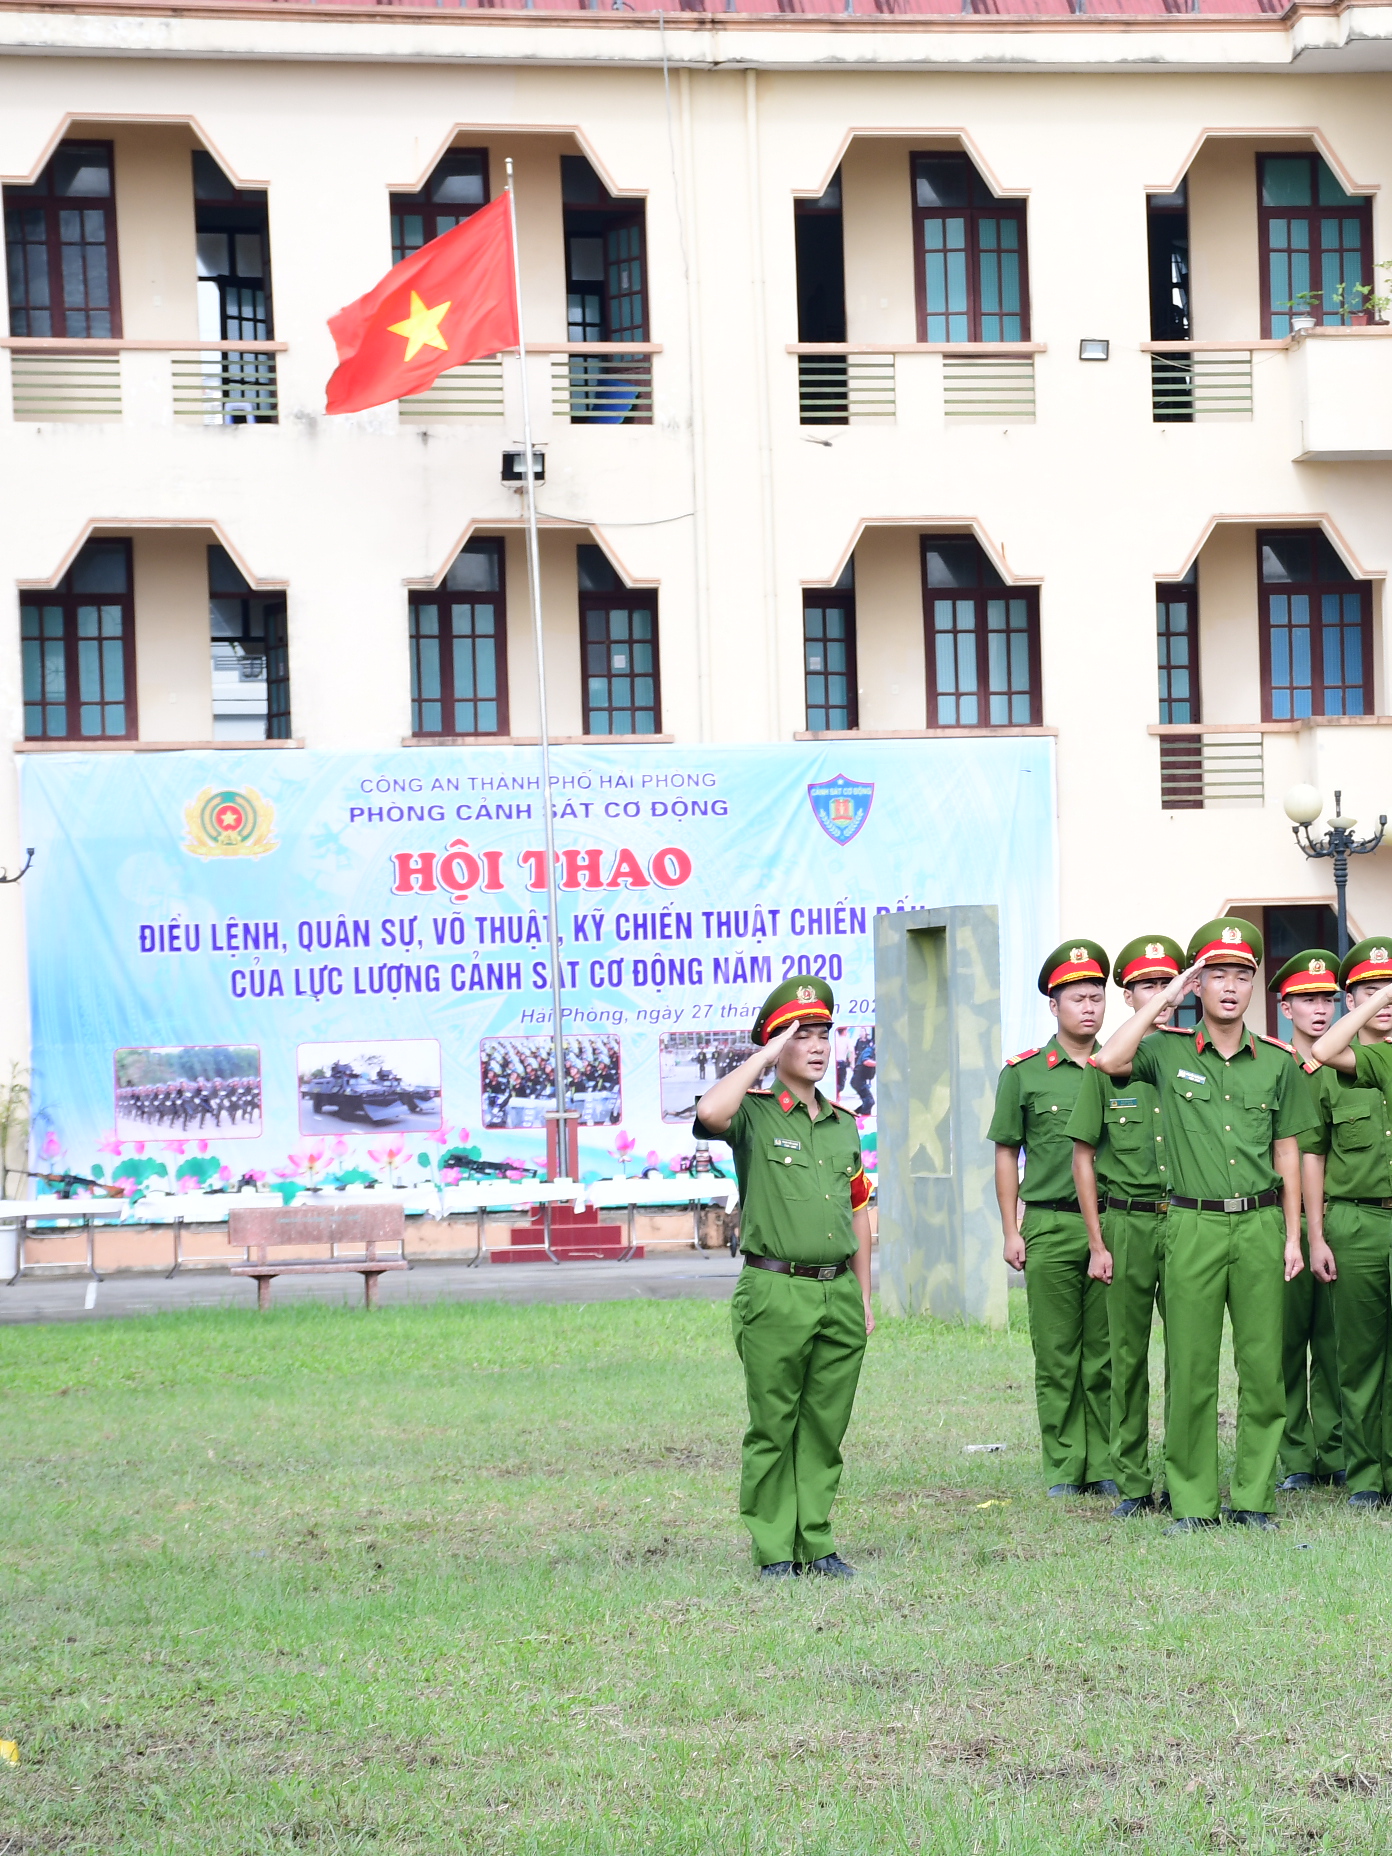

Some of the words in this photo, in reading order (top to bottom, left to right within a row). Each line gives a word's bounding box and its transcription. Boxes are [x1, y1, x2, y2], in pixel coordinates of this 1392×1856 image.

[360, 774, 423, 793] CÔNG
[430, 777, 460, 792] AN
[467, 772, 540, 791] THÀNH
[549, 769, 592, 789] PHỐ
[600, 770, 634, 789] HẢI
[641, 770, 717, 789] PHÒNG
[349, 801, 446, 823] PHÒNG
[456, 797, 532, 821] CẢNH
[604, 801, 641, 818] CƠ
[650, 796, 729, 822] ĐỘNG
[392, 837, 505, 902] HỘI
[518, 846, 693, 891] THAO
[138, 913, 201, 953] ĐIỀU
[211, 916, 288, 958] LỆNH,
[298, 913, 370, 952] QUÂN
[381, 915, 423, 953] SỰ,
[432, 911, 465, 945] VÕ
[573, 908, 605, 942] KỸ
[615, 901, 692, 941] CHIẾN
[702, 904, 781, 944] THUẬT
[790, 897, 867, 936] CHIẾN
[231, 956, 284, 998] CỦA
[294, 964, 343, 1002] LỰC
[354, 962, 440, 1000] LƯỢNG
[451, 950, 522, 992] CẢNH
[590, 957, 625, 989] CƠ
[632, 952, 703, 993] ĐỘNG
[713, 950, 773, 984] NĂM
[781, 953, 843, 982] 2020
[560, 1006, 628, 1026] Phòng,
[636, 1005, 685, 1025] ngày
[692, 1004, 714, 1019] 27
[720, 1003, 762, 1018] thán
[848, 998, 876, 1014] 20
